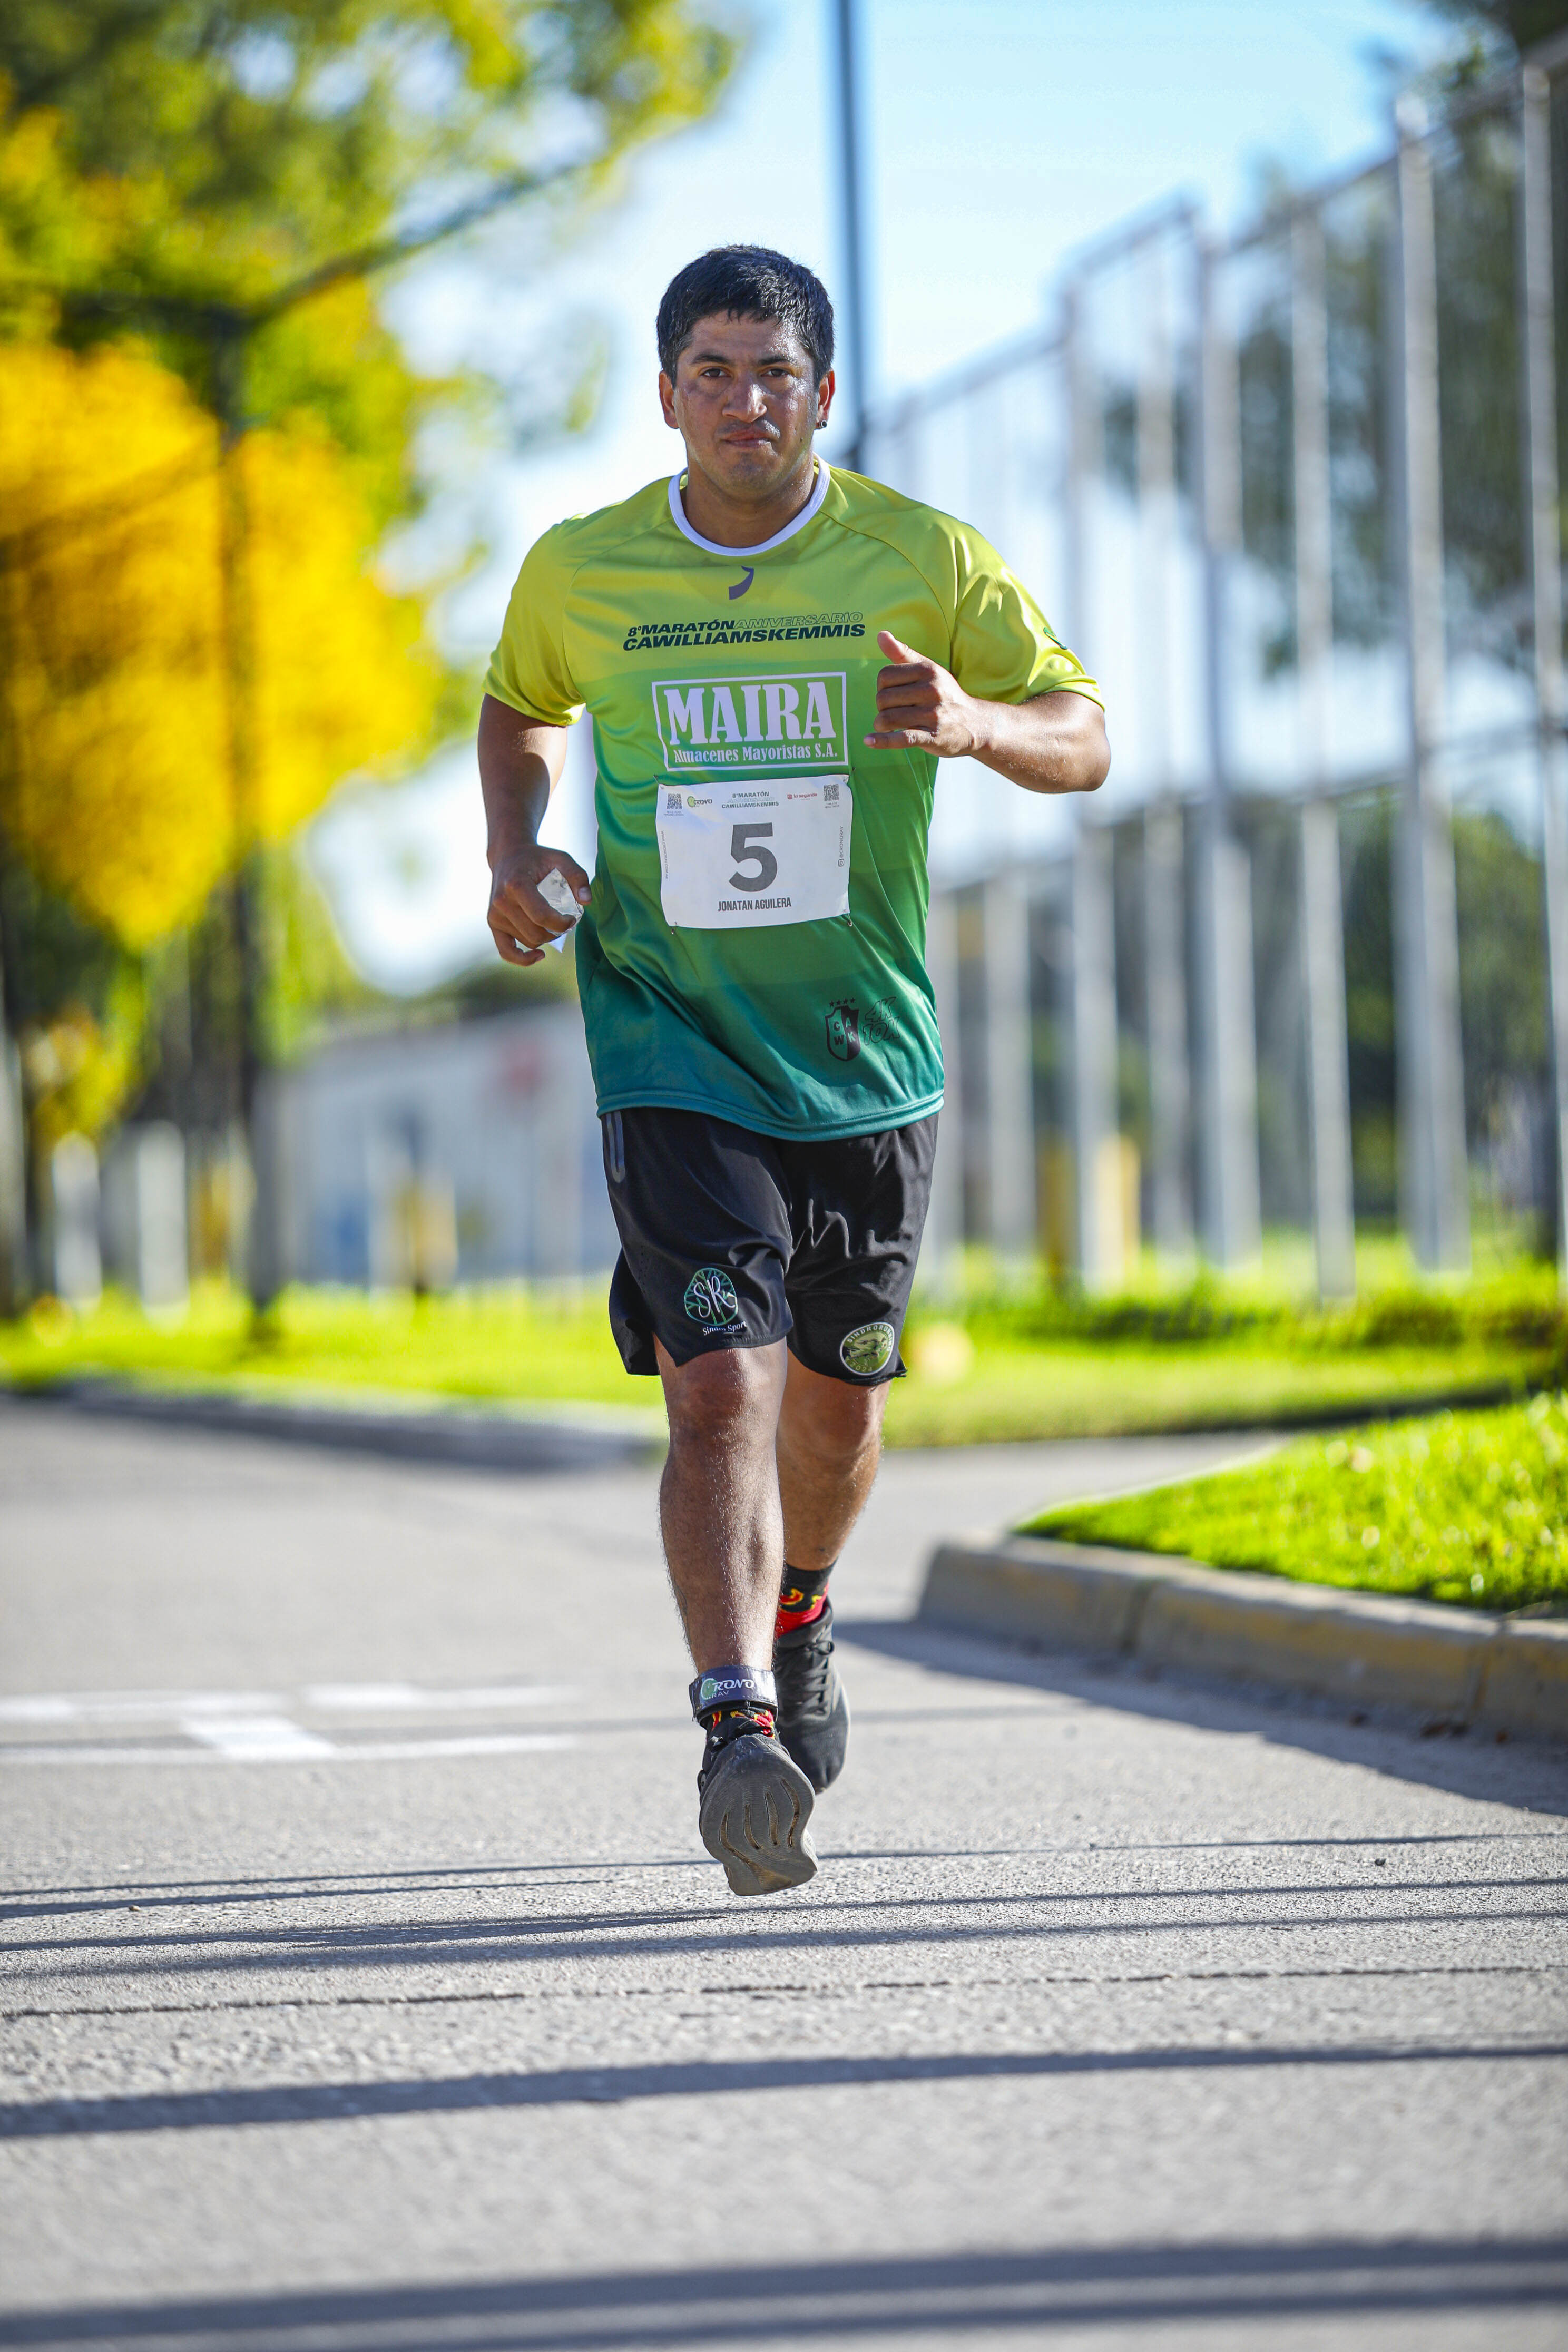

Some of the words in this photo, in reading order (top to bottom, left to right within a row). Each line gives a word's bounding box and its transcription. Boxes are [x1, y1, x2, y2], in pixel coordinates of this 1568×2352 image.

[733, 612, 864, 630] ANIVERSARIO
[623, 623, 866, 651] CAWILLIAMSKEMMIS
[663, 681, 837, 745] MAIRA
[673, 749, 739, 763] Almacenes
[742, 744, 811, 762] Mayoristas
[815, 742, 838, 758] S.A.
[729, 822, 778, 893] 5
[718, 900, 753, 912] JONATAN
[754, 897, 792, 910] AGUILERA
[727, 1320, 747, 1332] Sport
[711, 1690, 729, 1698] RAV
